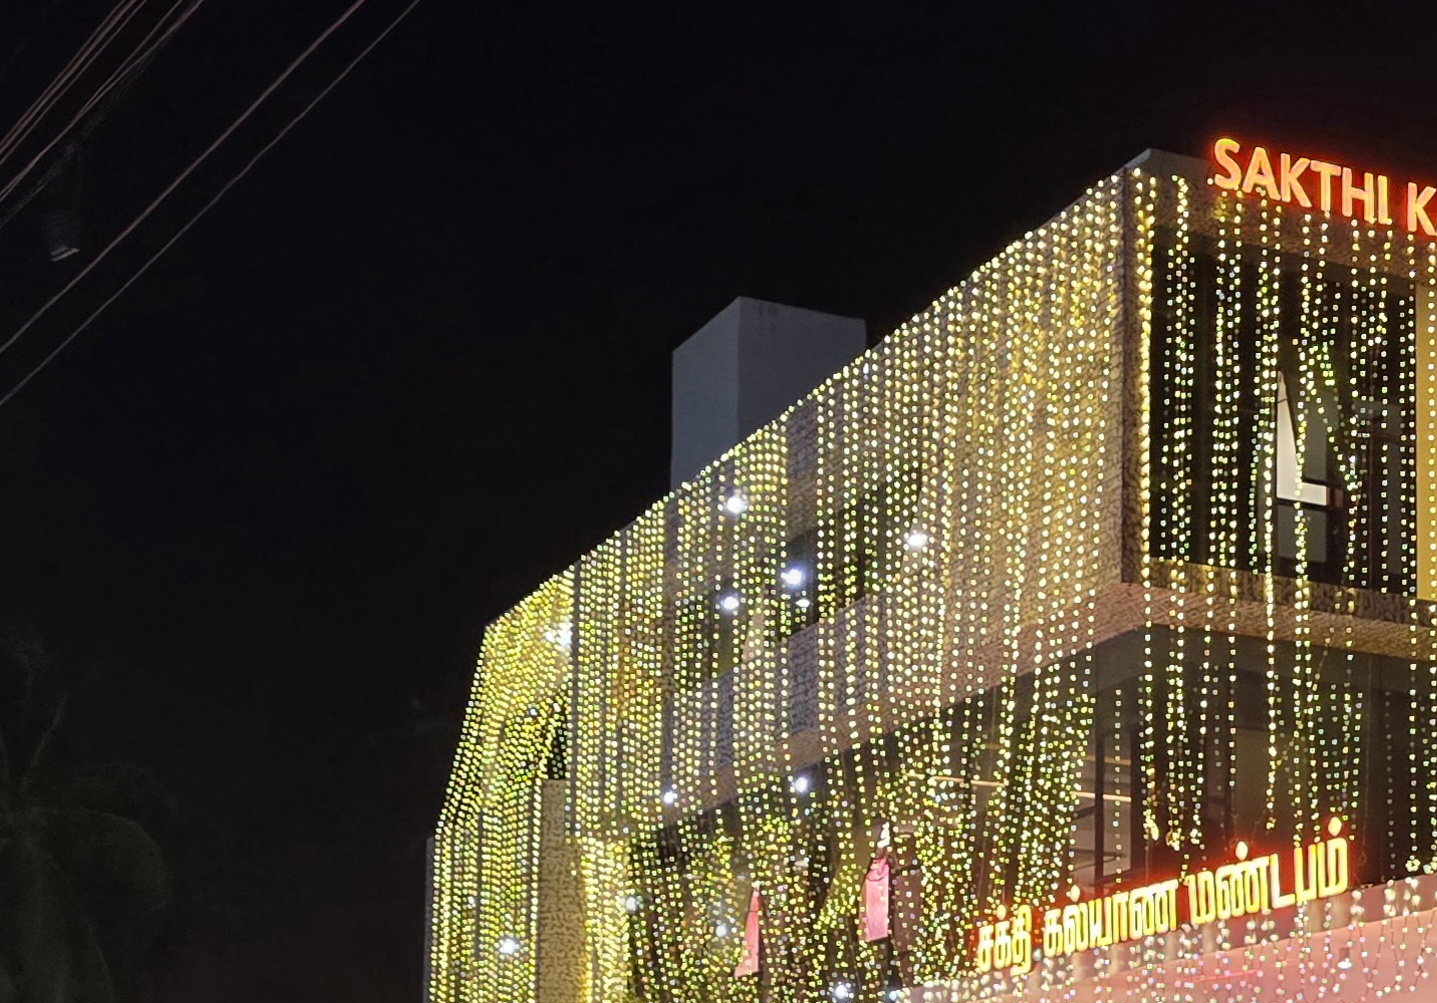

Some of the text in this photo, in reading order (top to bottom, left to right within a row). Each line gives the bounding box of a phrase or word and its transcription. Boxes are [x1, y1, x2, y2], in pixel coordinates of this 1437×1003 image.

[1213, 137, 1392, 225] SAKTHI
[977, 816, 1349, 977] சக்தி கல்யாண மண்டபம்
